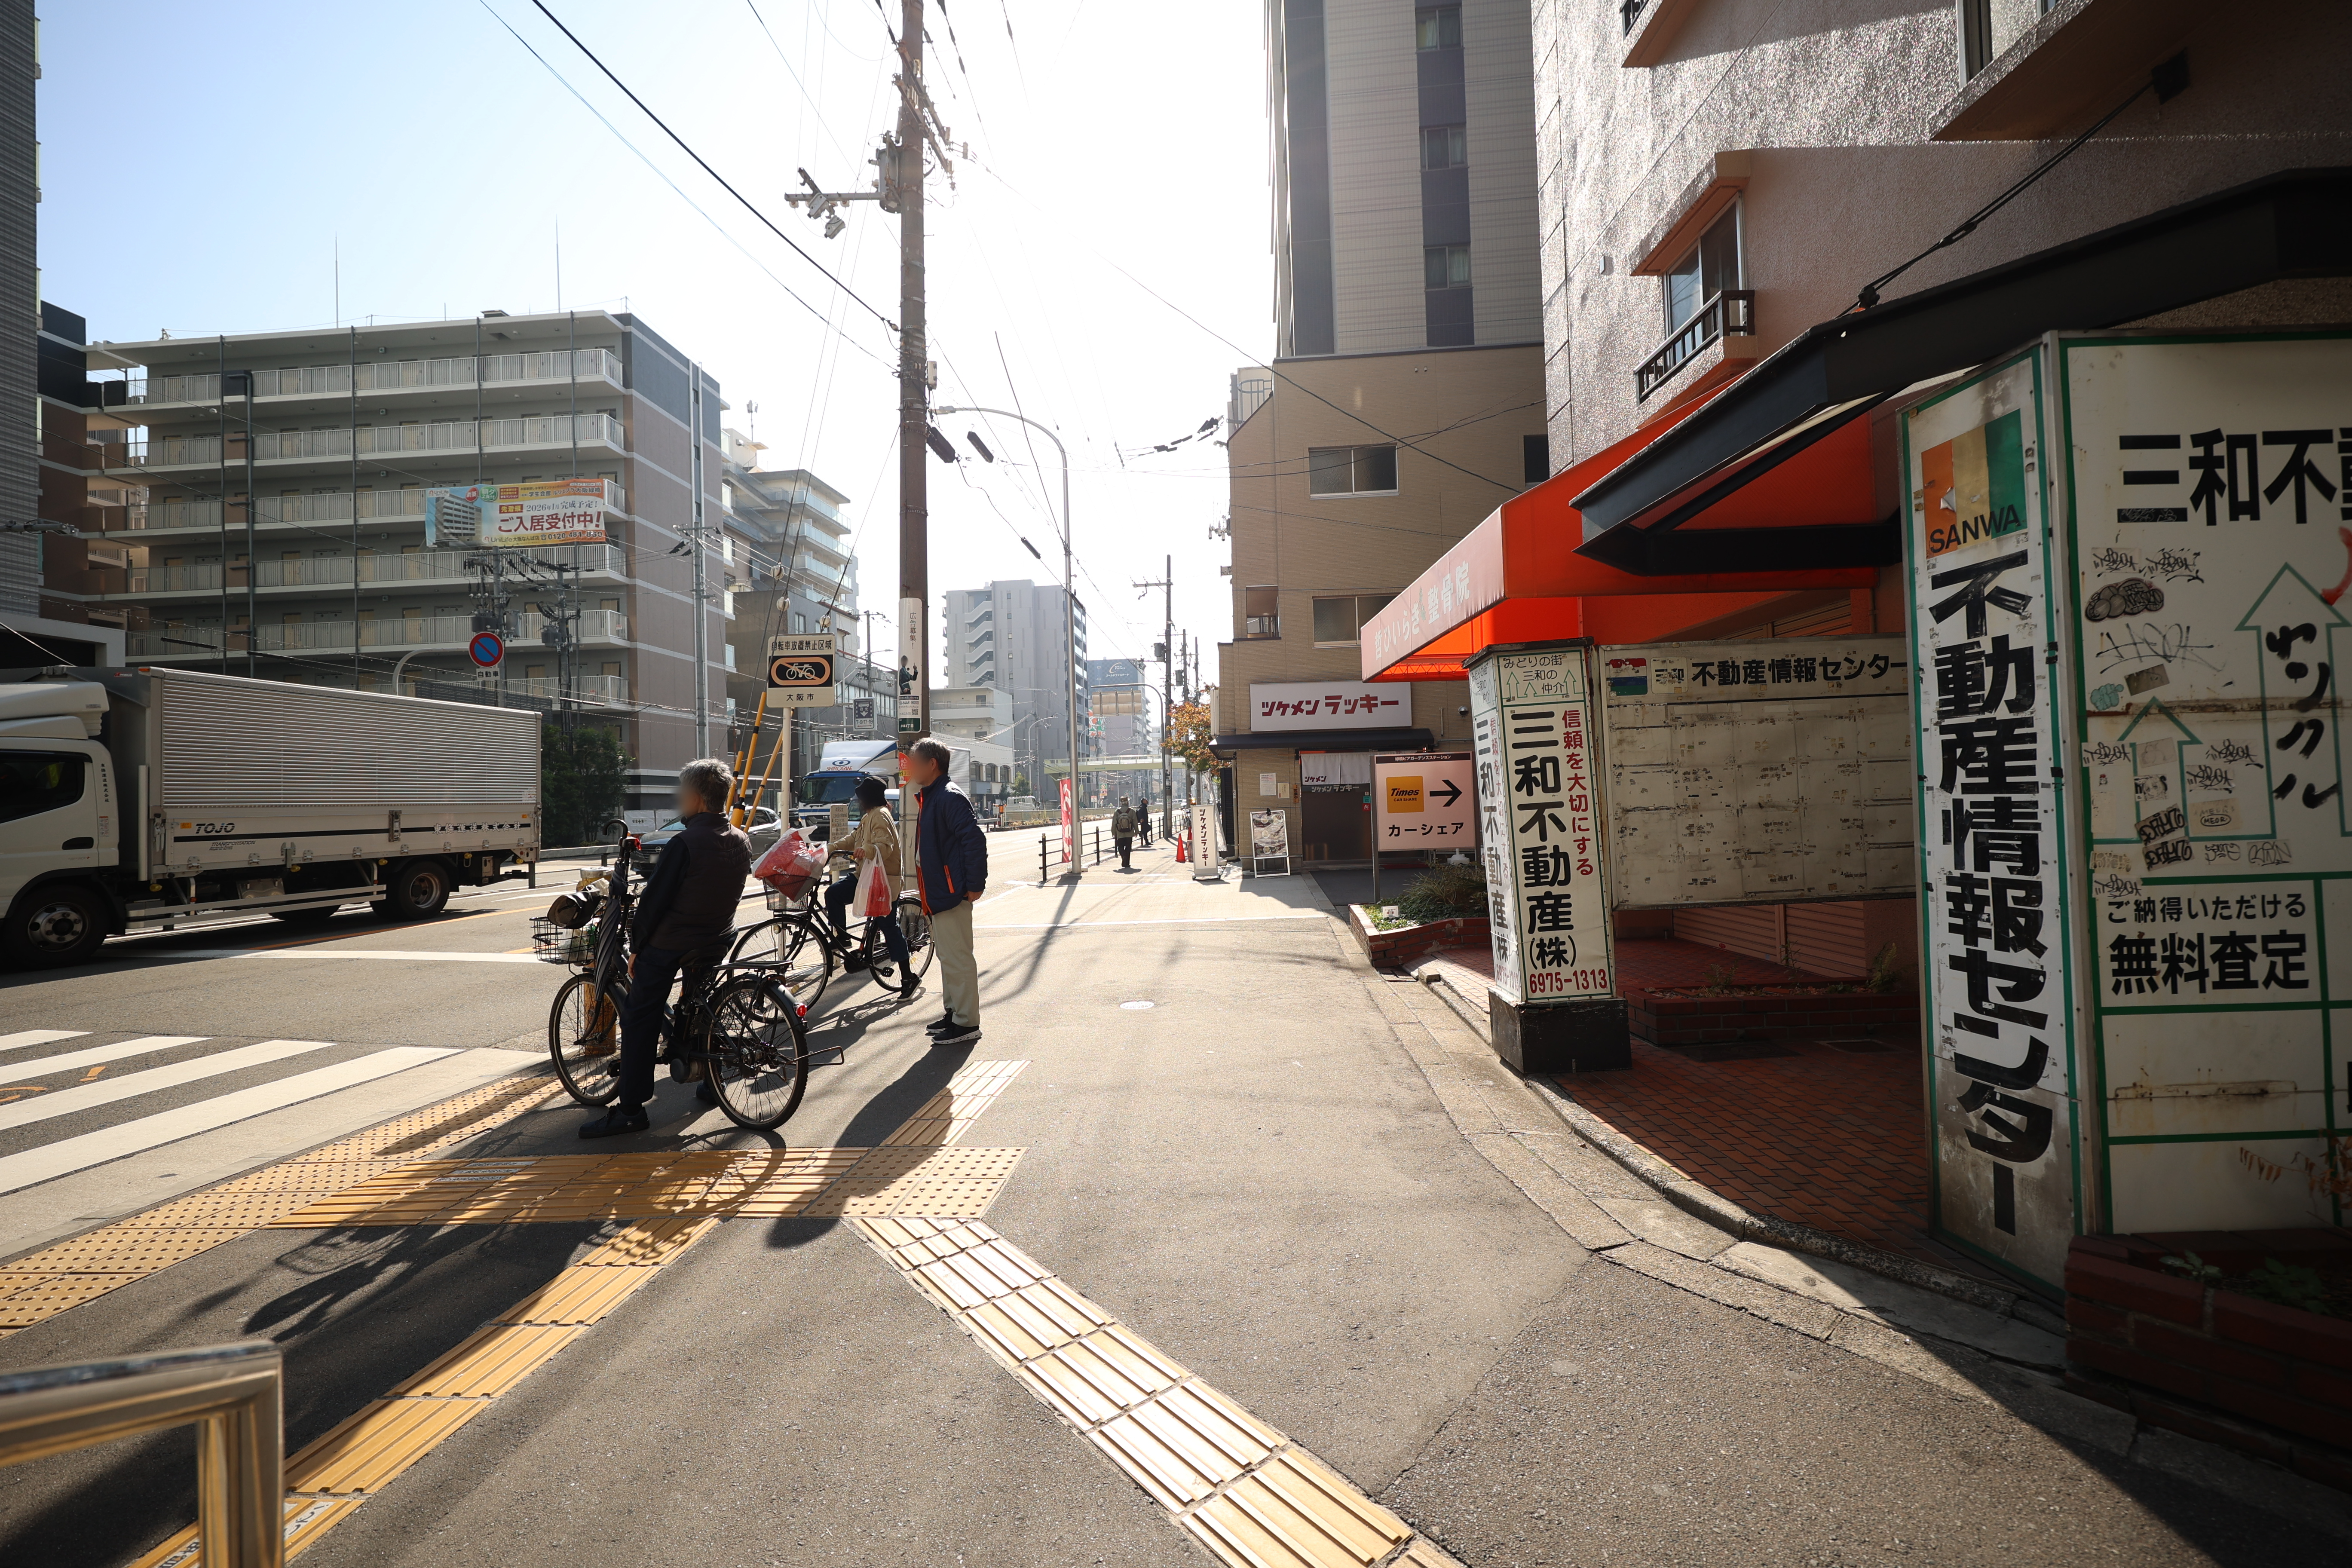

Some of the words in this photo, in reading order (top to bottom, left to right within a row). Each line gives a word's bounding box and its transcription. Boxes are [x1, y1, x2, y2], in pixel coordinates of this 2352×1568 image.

[2117, 427, 2352, 526] 三和不
[498, 511, 602, 533] ご入居受付中!
[1930, 503, 2021, 554] SANWA
[1427, 560, 1470, 625] 整骨院
[771, 639, 832, 651] 自転車放置禁止区域
[1504, 654, 1563, 669] みどりの街
[1522, 669, 1558, 682] 三和の
[1692, 653, 1907, 687] 不動産情報センター
[1541, 683, 1565, 695] 仲介
[1262, 699, 1320, 717] ツケメン
[1324, 694, 1399, 715] ラッキー
[1390, 788, 1420, 796] Times
[1562, 709, 1594, 876] 信頼を大切にする
[195, 822, 235, 834] TOJO
[432, 821, 521, 835] 東條運送株式会社
[1199, 808, 1209, 867] ツケメンラッキー
[1388, 822, 1464, 837] カーシェア
[1476, 719, 1511, 965] 三和不動産(株)
[1511, 710, 1577, 970] 三和不動産(株)
[1929, 548, 2053, 1237] 不動産情報センター
[2107, 893, 2306, 924] ご納得いただける
[2109, 929, 2309, 996] 無料査定
[1529, 968, 1608, 994] 6975-1313
